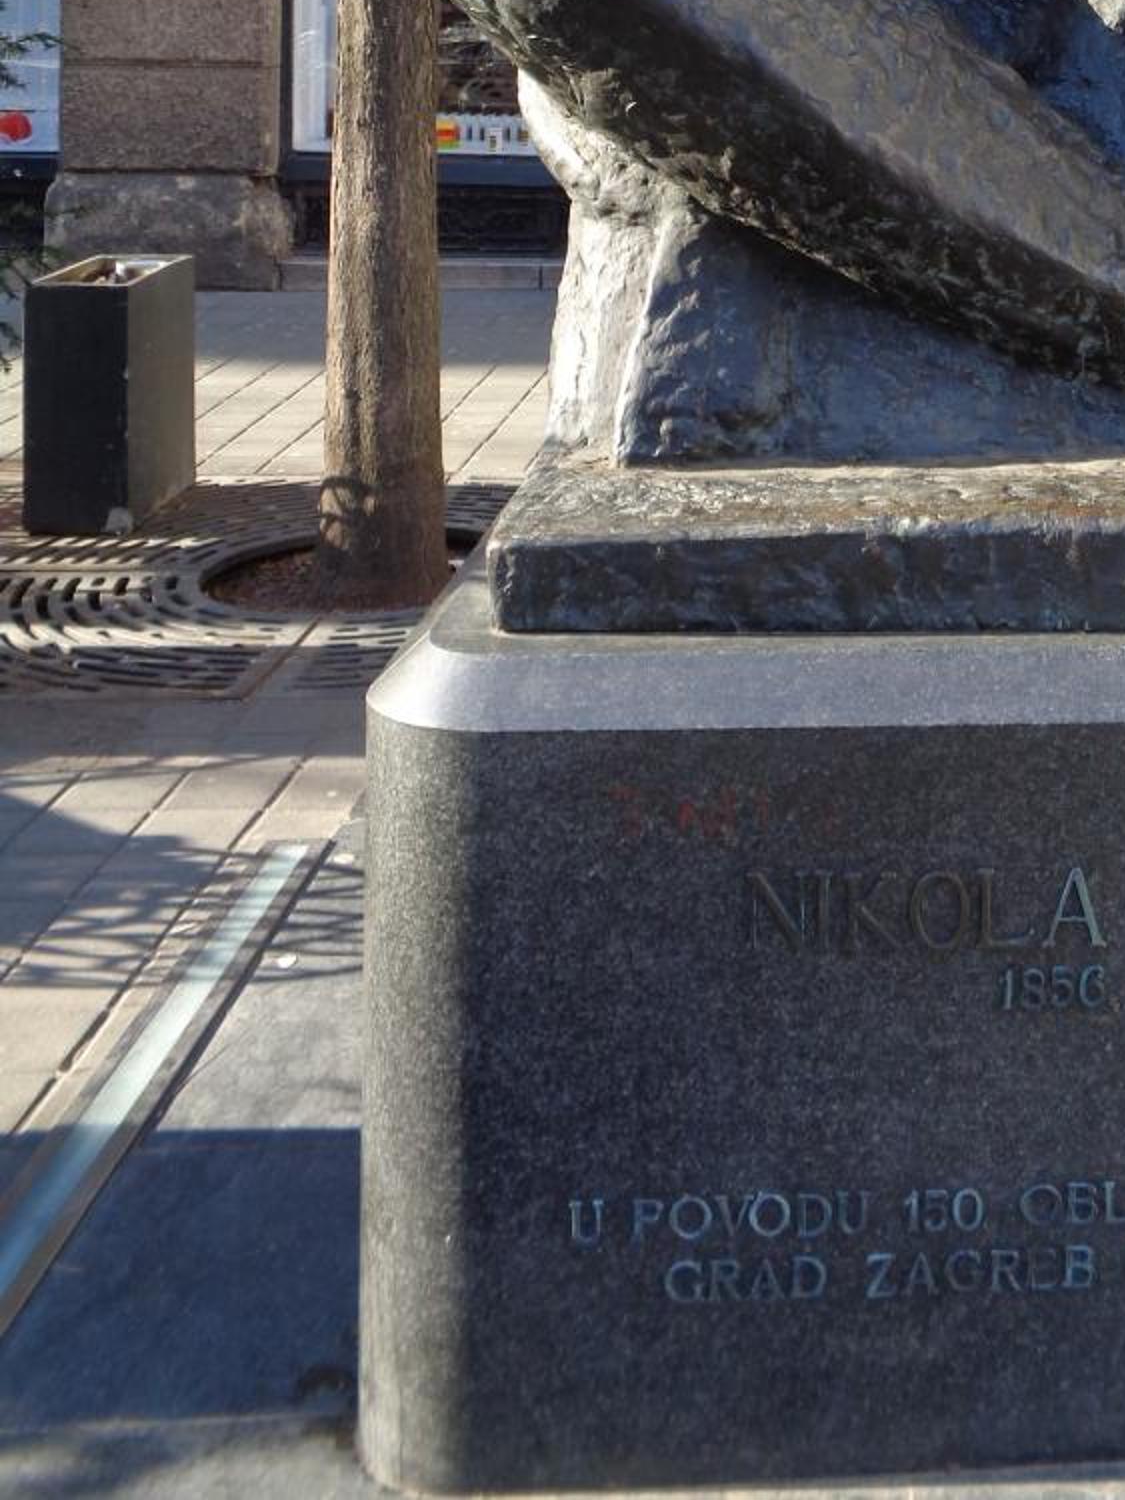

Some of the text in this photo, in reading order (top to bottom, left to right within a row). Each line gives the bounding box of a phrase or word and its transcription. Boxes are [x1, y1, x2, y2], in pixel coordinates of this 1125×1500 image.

[744, 866, 1109, 952] NIKOLA
[568, 1198, 604, 1245] U
[632, 1190, 872, 1243] POVODU
[664, 1255, 828, 1302] GRAD
[865, 1245, 1098, 1299] ZAGREB
